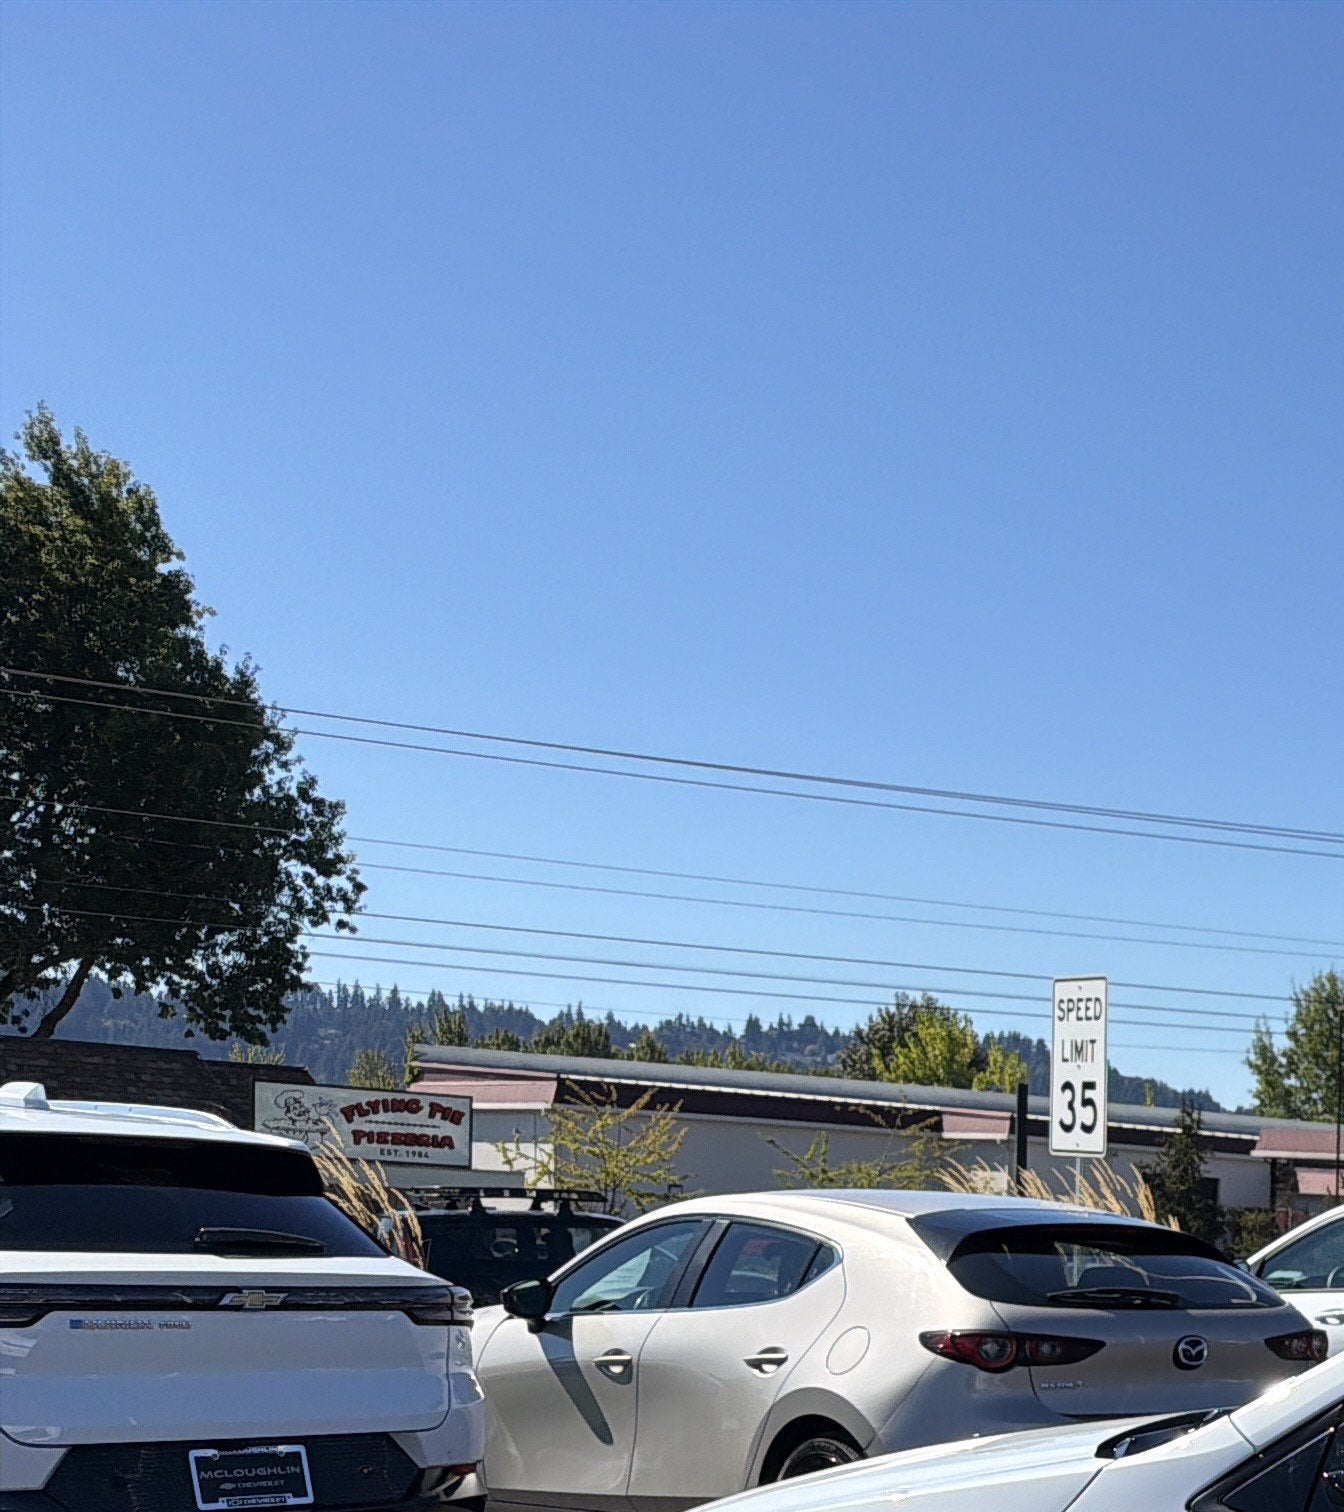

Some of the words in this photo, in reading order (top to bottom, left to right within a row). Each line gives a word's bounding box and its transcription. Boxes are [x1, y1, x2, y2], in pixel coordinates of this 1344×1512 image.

[1057, 997, 1103, 1022] SPEED
[1061, 1039, 1097, 1063] LIMIT
[340, 1098, 424, 1124] FLYING
[428, 1101, 466, 1126] PIE
[1059, 1080, 1098, 1134] 35
[351, 1129, 455, 1150] PIZZERIA
